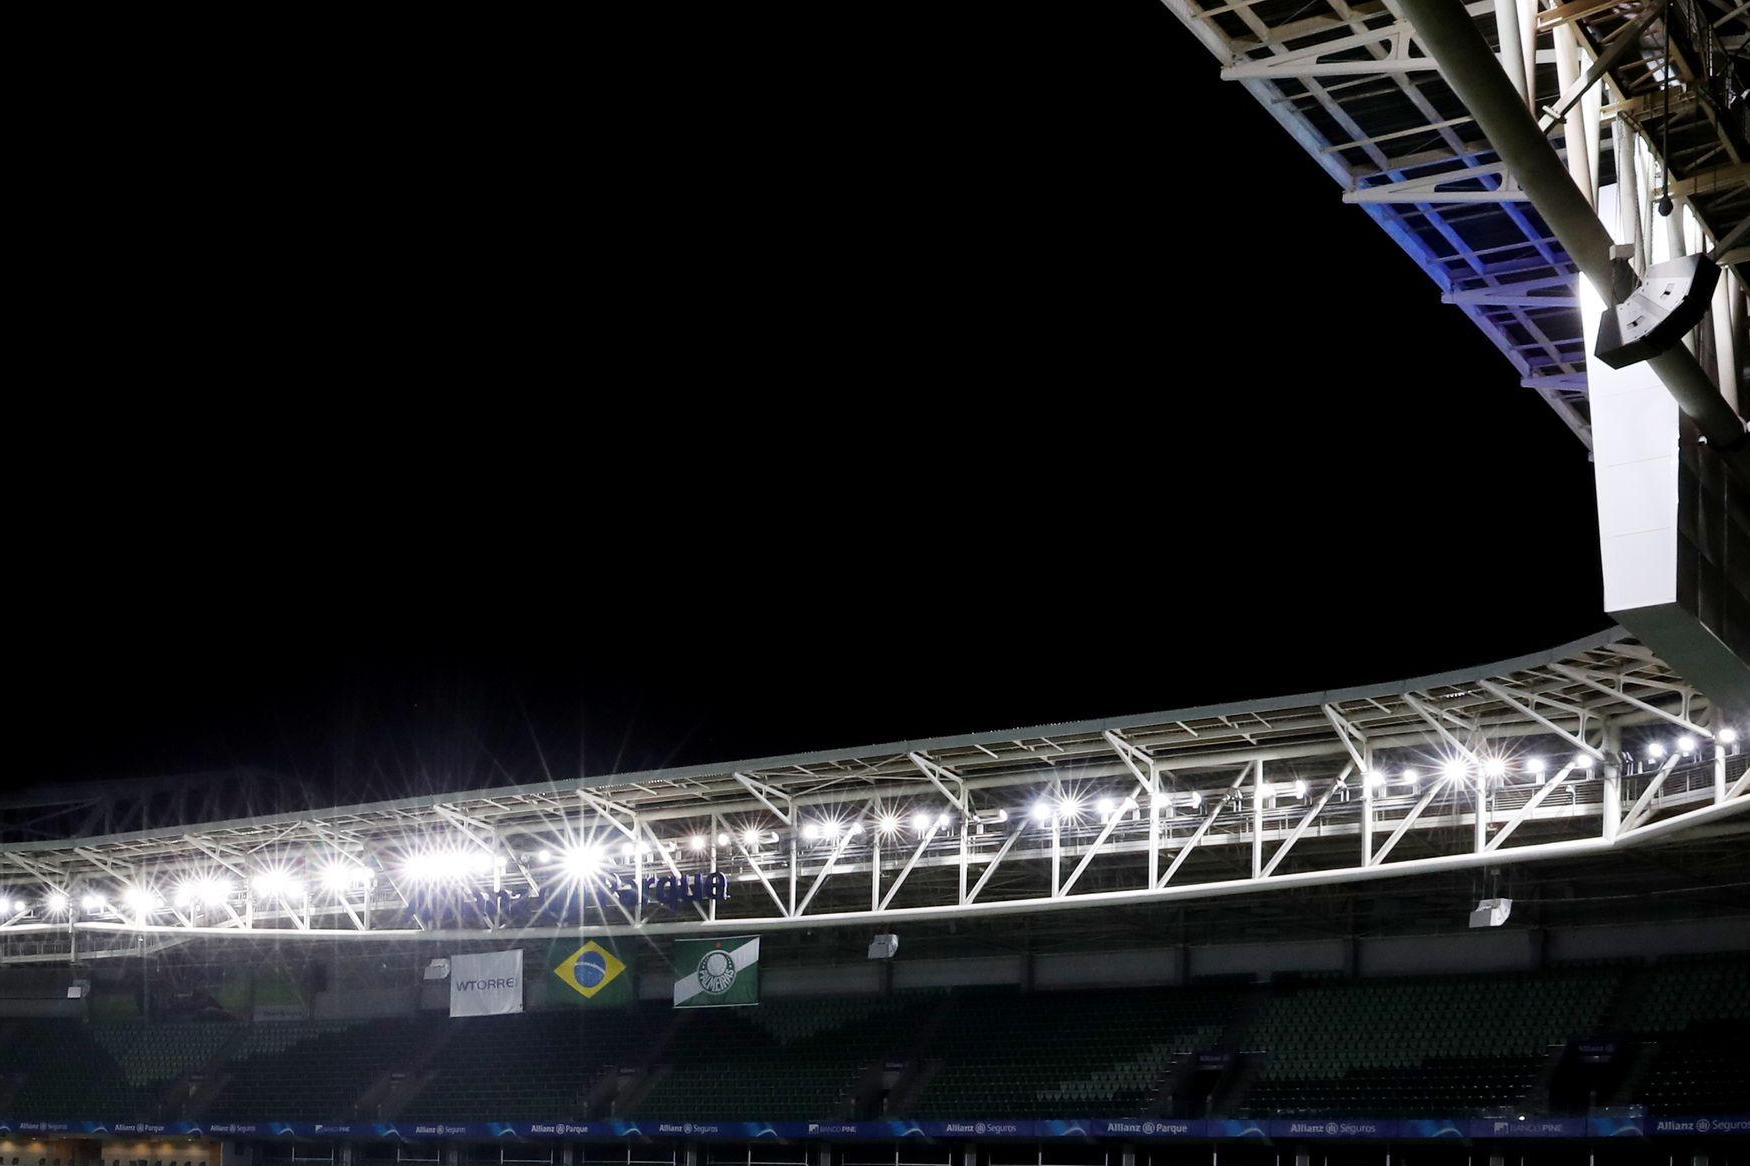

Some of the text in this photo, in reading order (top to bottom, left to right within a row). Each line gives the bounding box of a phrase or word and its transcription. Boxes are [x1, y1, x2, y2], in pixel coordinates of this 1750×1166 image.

[531, 1124, 589, 1134] Allianz Parque
[659, 1124, 718, 1134] Allianz Seguros
[946, 1123, 1017, 1134] Allianz Seguros
[1107, 1122, 1188, 1134] Allianz Parque
[1290, 1123, 1376, 1134] Allianz Seguros
[1657, 1120, 1694, 1131] Allianz
